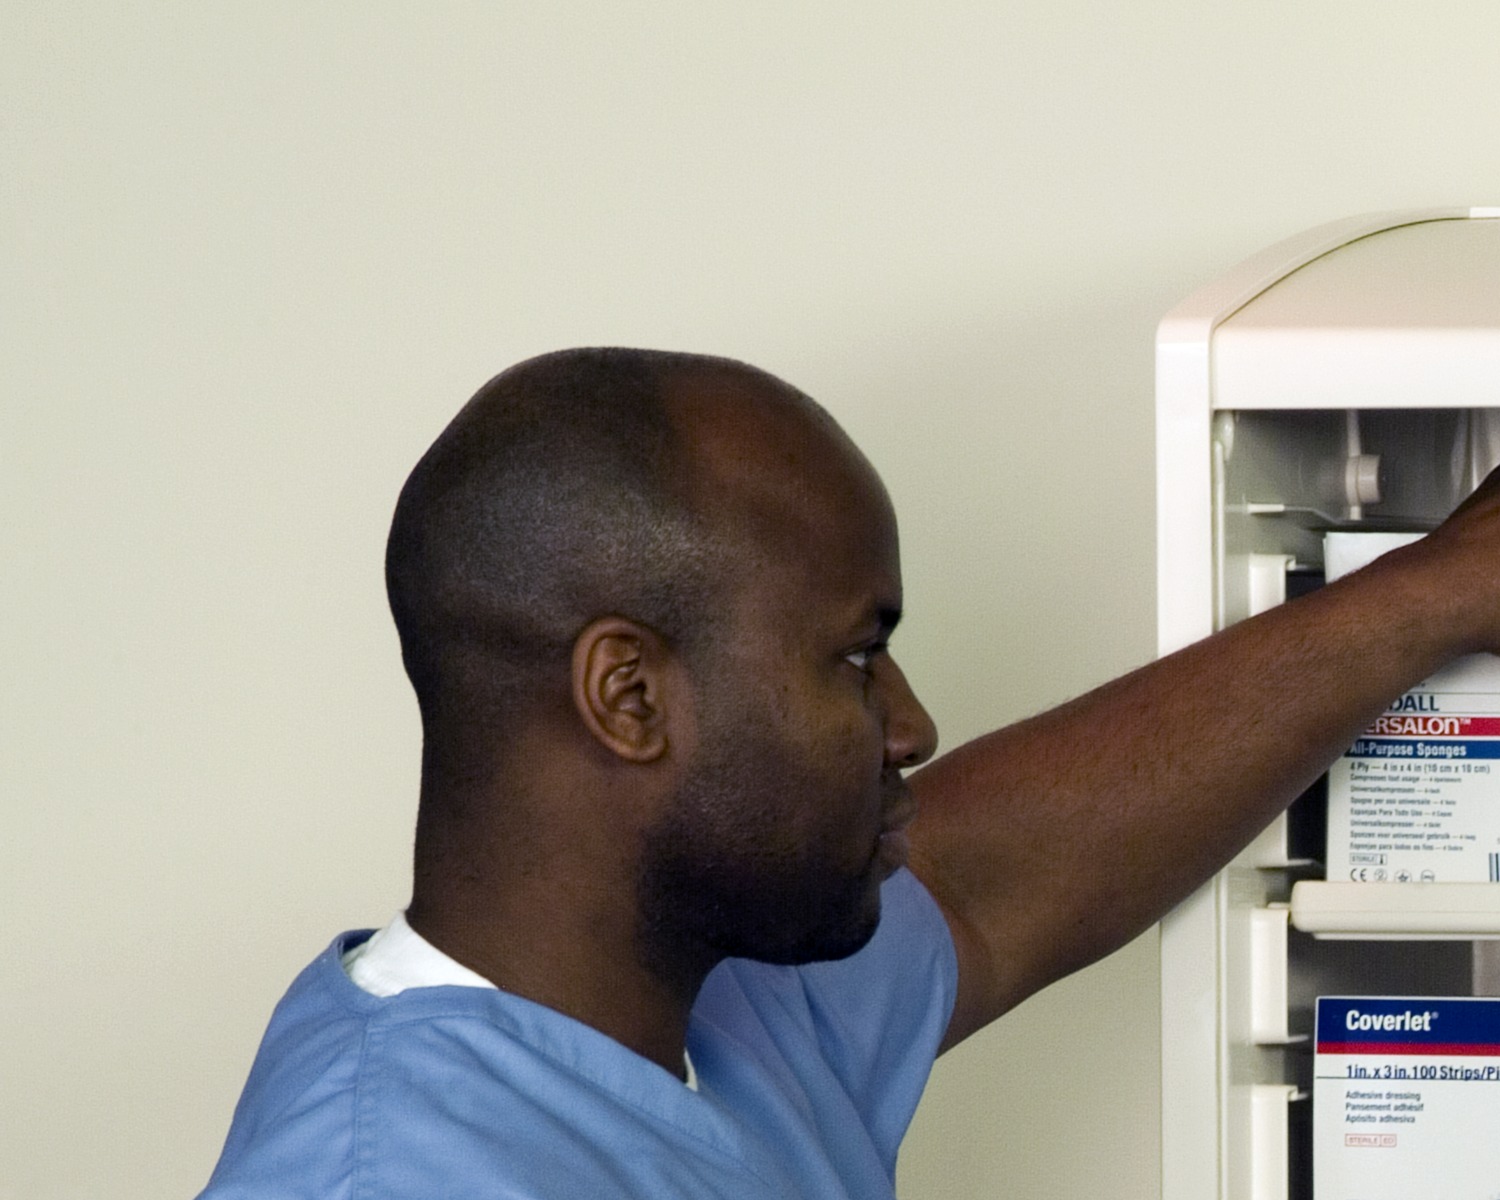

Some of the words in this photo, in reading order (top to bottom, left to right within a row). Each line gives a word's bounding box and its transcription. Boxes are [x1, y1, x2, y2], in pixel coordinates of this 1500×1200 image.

[1390, 696, 1440, 711] DALL
[1351, 742, 1413, 756] All-Purpose
[1417, 743, 1467, 756] Sponges
[1346, 1091, 1383, 1100] Adhesive
[1385, 1091, 1421, 1101] dressing
[1346, 1103, 1391, 1111] Pansement
